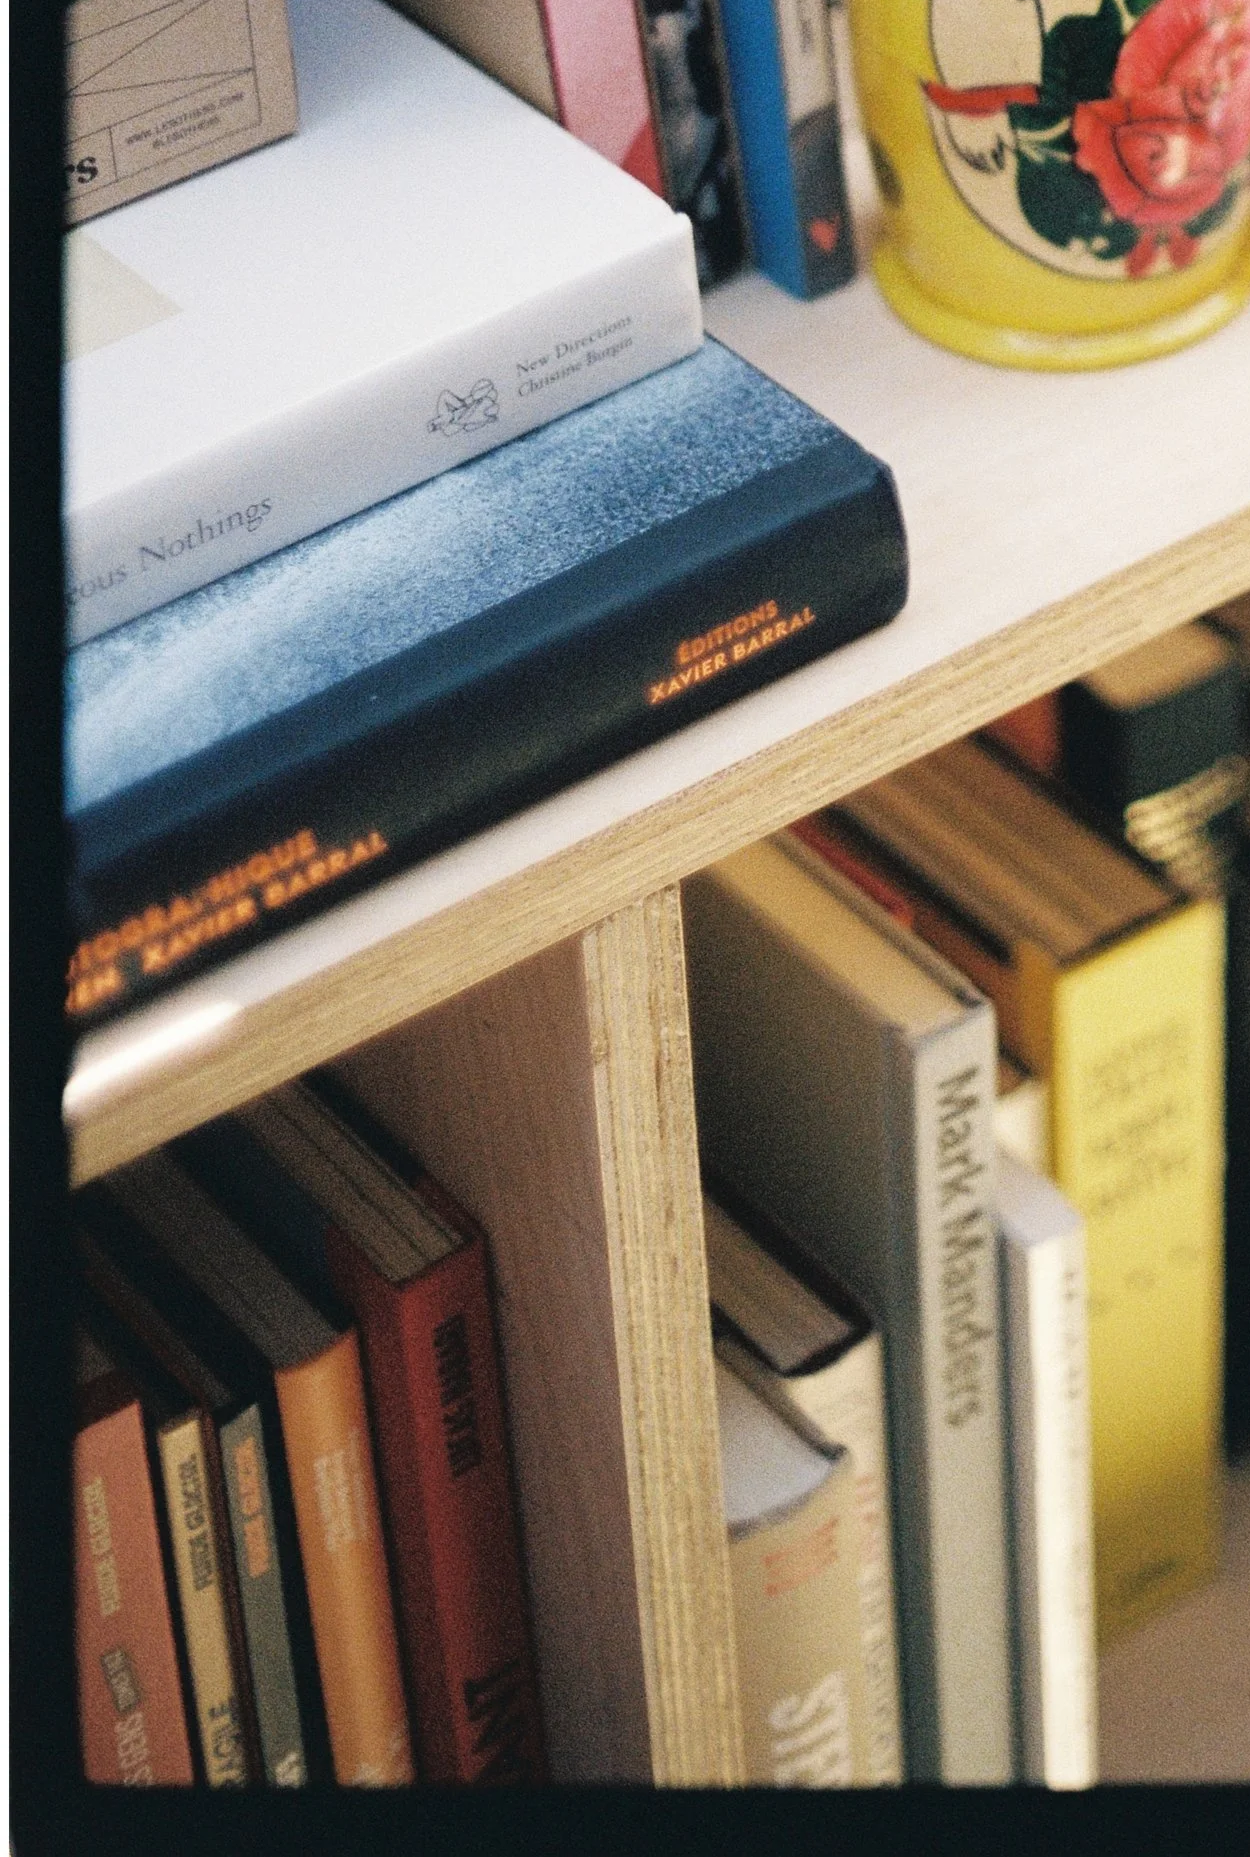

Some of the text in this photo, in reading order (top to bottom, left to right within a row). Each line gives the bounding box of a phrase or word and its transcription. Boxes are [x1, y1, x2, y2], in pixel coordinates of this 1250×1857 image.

[516, 316, 631, 377] New Directions
[518, 362, 582, 397] Christine
[72, 497, 273, 599] ous Nothings
[648, 606, 816, 705] XAVIER BARRAL
[143, 896, 257, 974] XAVIER
[264, 830, 388, 908] BARRAL
[936, 1064, 993, 1427] Mark Manders
